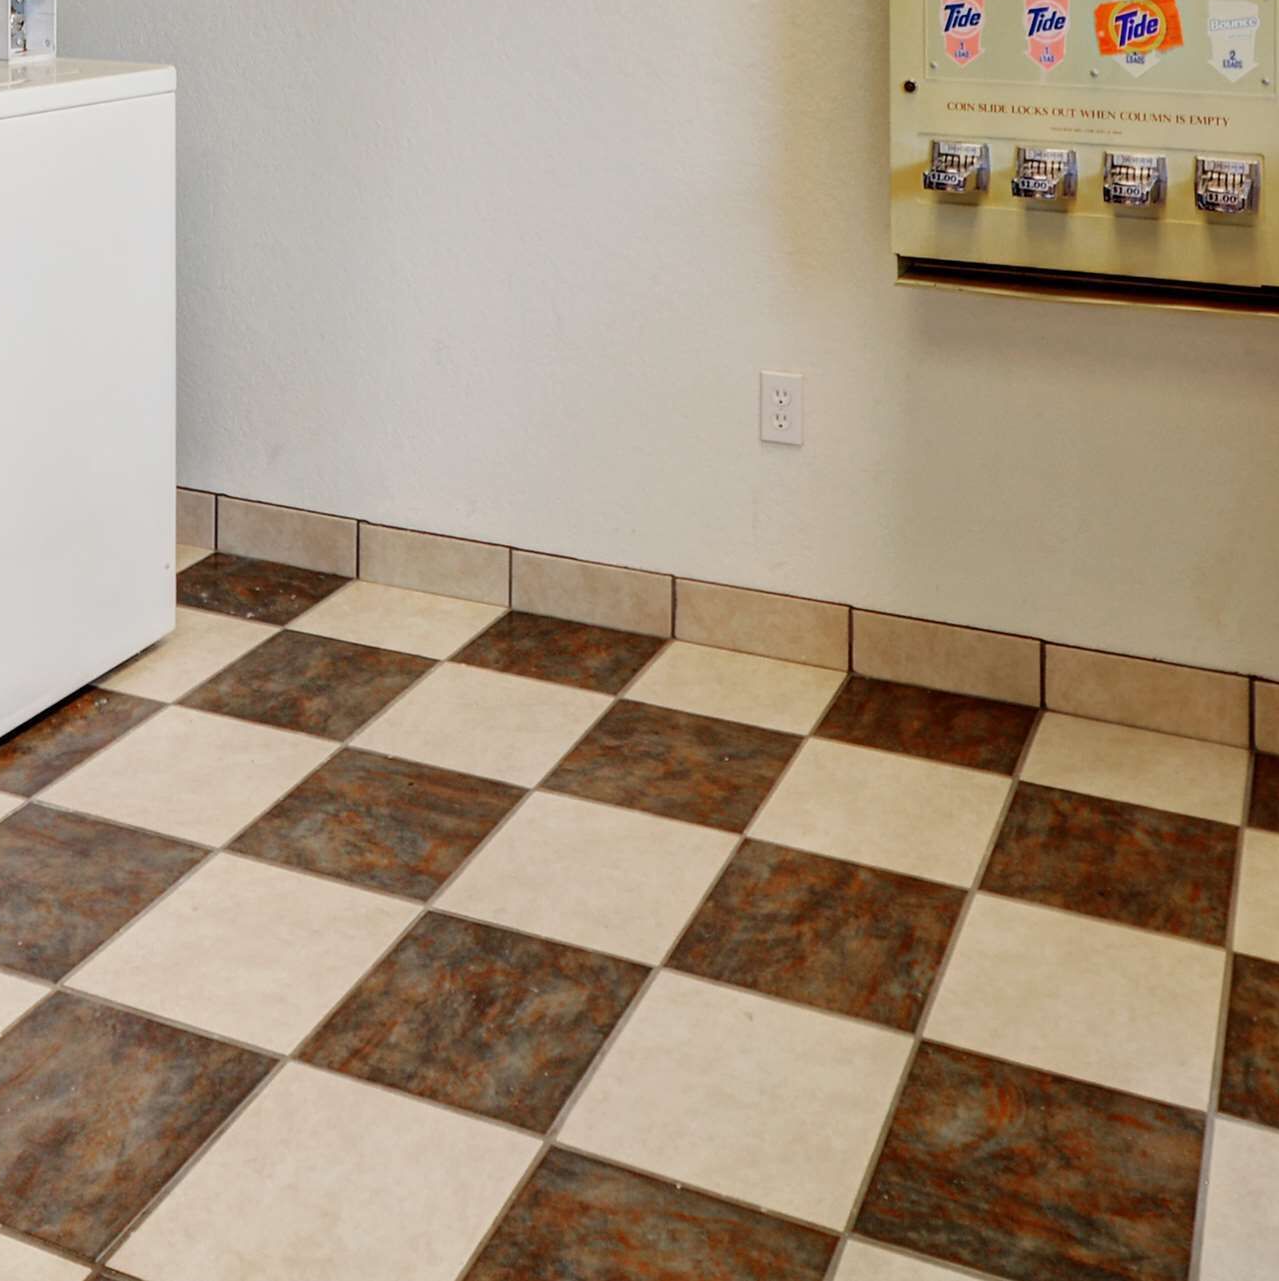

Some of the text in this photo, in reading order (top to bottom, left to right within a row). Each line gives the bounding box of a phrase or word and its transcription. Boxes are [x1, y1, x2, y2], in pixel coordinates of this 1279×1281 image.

[944, 3, 982, 32] Tide
[1027, 7, 1066, 37] Tide
[1115, 10, 1159, 47] Tide
[1229, 50, 1236, 60] 2
[947, 102, 1230, 127] COIN SLIDE LOCKS OUT WHEN COLUMN IS EMPTY
[930, 173, 958, 183] $1.00
[1020, 180, 1048, 190] $1.00
[1112, 185, 1140, 195] $1.00
[1207, 192, 1237, 203] $1.00
